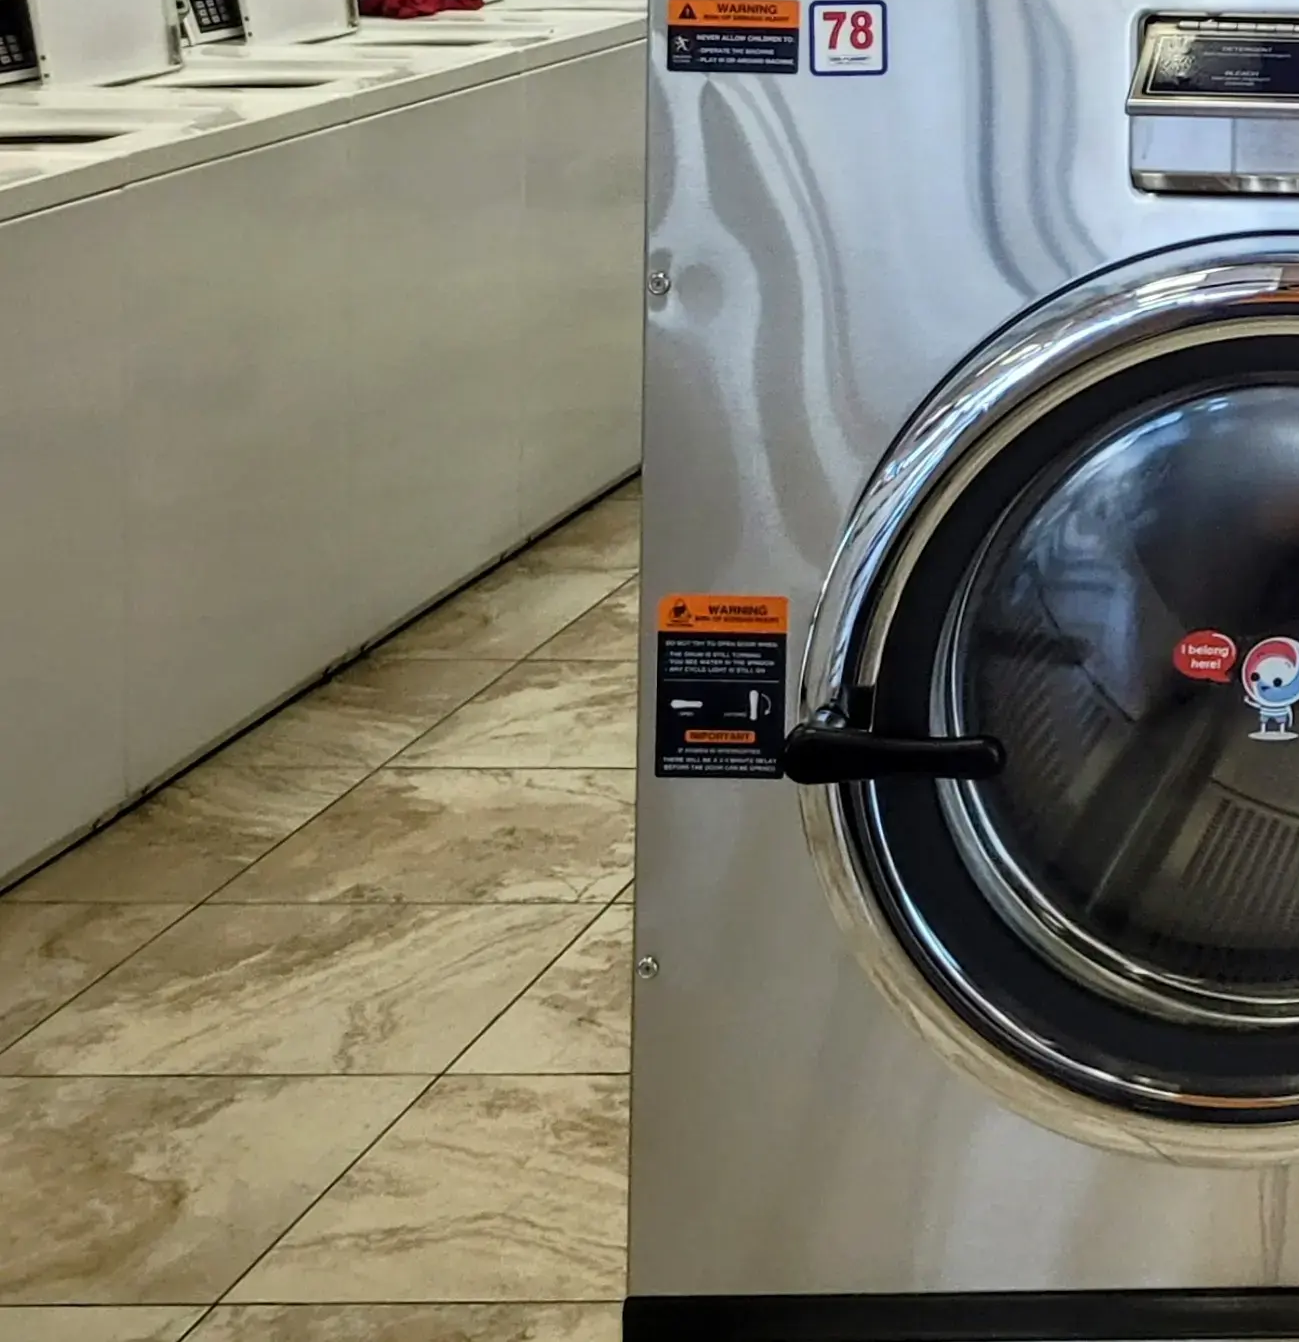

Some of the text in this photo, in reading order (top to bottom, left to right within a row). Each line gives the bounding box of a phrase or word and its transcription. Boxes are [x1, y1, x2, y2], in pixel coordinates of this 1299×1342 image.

[717, 3, 778, 16] WARNING
[822, 10, 875, 50] 78
[708, 604, 768, 616] WARNING
[1181, 644, 1230, 658] I belong
[1190, 659, 1221, 670] here!
